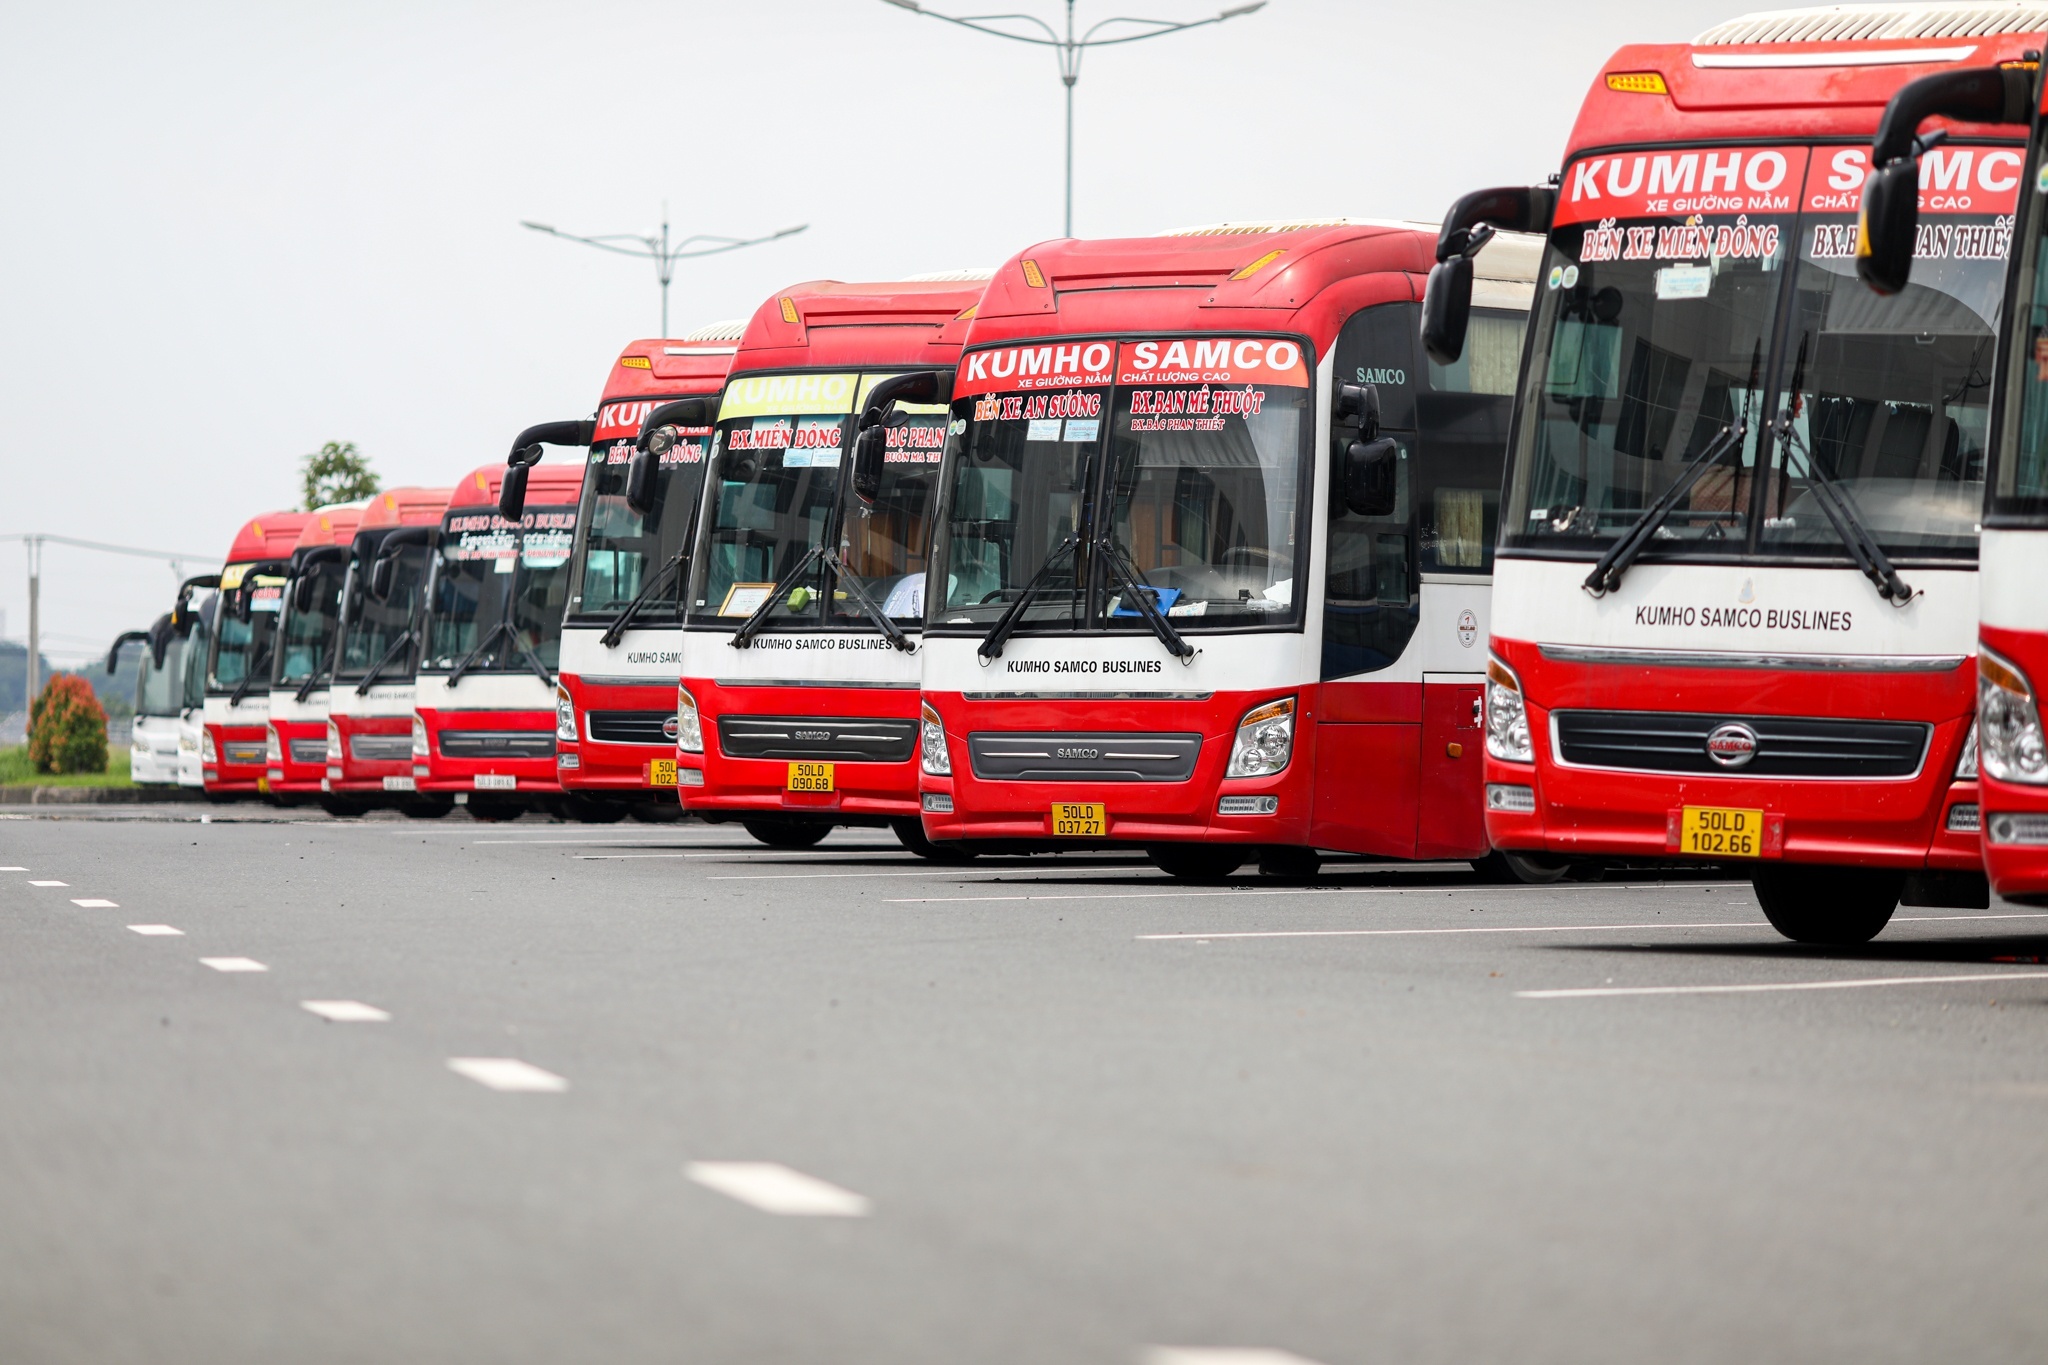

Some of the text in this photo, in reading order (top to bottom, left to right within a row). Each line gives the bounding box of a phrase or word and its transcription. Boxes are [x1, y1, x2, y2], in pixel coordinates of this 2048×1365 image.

[1571, 148, 2021, 203] KUMHO SMC
[1645, 199, 1669, 213] XE
[1672, 194, 1744, 211] GIƯỜNG
[1810, 190, 1859, 209] CHẤT
[1930, 195, 1972, 210] CAO
[1580, 213, 1779, 263] BẾN XE MIỀN ĐÔNG
[1810, 223, 1860, 259] BX.B
[967, 340, 1299, 382] KUMHO SAMCO
[1017, 379, 1033, 389] XE
[1035, 374, 1083, 387] GIƯỜNG
[1121, 369, 1231, 384] CHẤT LƯỢNG CAO
[1356, 366, 1406, 385] SAMCO
[725, 376, 848, 407] KUMHO
[974, 388, 1101, 422] BẾN XE AN SƯƠNG
[1129, 383, 1265, 420] BX.BAN MÊ THUỘT
[601, 401, 658, 429] KUM
[1166, 417, 1196, 431] PHAN
[1195, 413, 1226, 431] THIẾT
[794, 420, 842, 449] ĐÔNG
[908, 427, 946, 449] PHAN
[607, 438, 631, 465] BẾN
[910, 451, 926, 463] MA
[1635, 606, 1853, 631] KUMHO SAMCO BUSLINES
[753, 638, 893, 650] KUMHO SAMCO BUSLINES
[627, 652, 682, 664] KUMHO SAMC
[1007, 660, 1162, 673] KUMHO SAMCO BUSLINES
[795, 731, 831, 741] SAMCO
[1057, 748, 1099, 759] SAMCO
[1709, 739, 1752, 752] SAMCO
[659, 761, 677, 773] 50L
[797, 764, 824, 777] 50LD
[655, 773, 678, 785] 102.
[792, 777, 829, 790] 090.68
[1062, 805, 1094, 819] 50LD
[1058, 820, 1099, 834] 037.27
[1699, 811, 1746, 832] 50LD
[1691, 832, 1752, 854] 102.66
